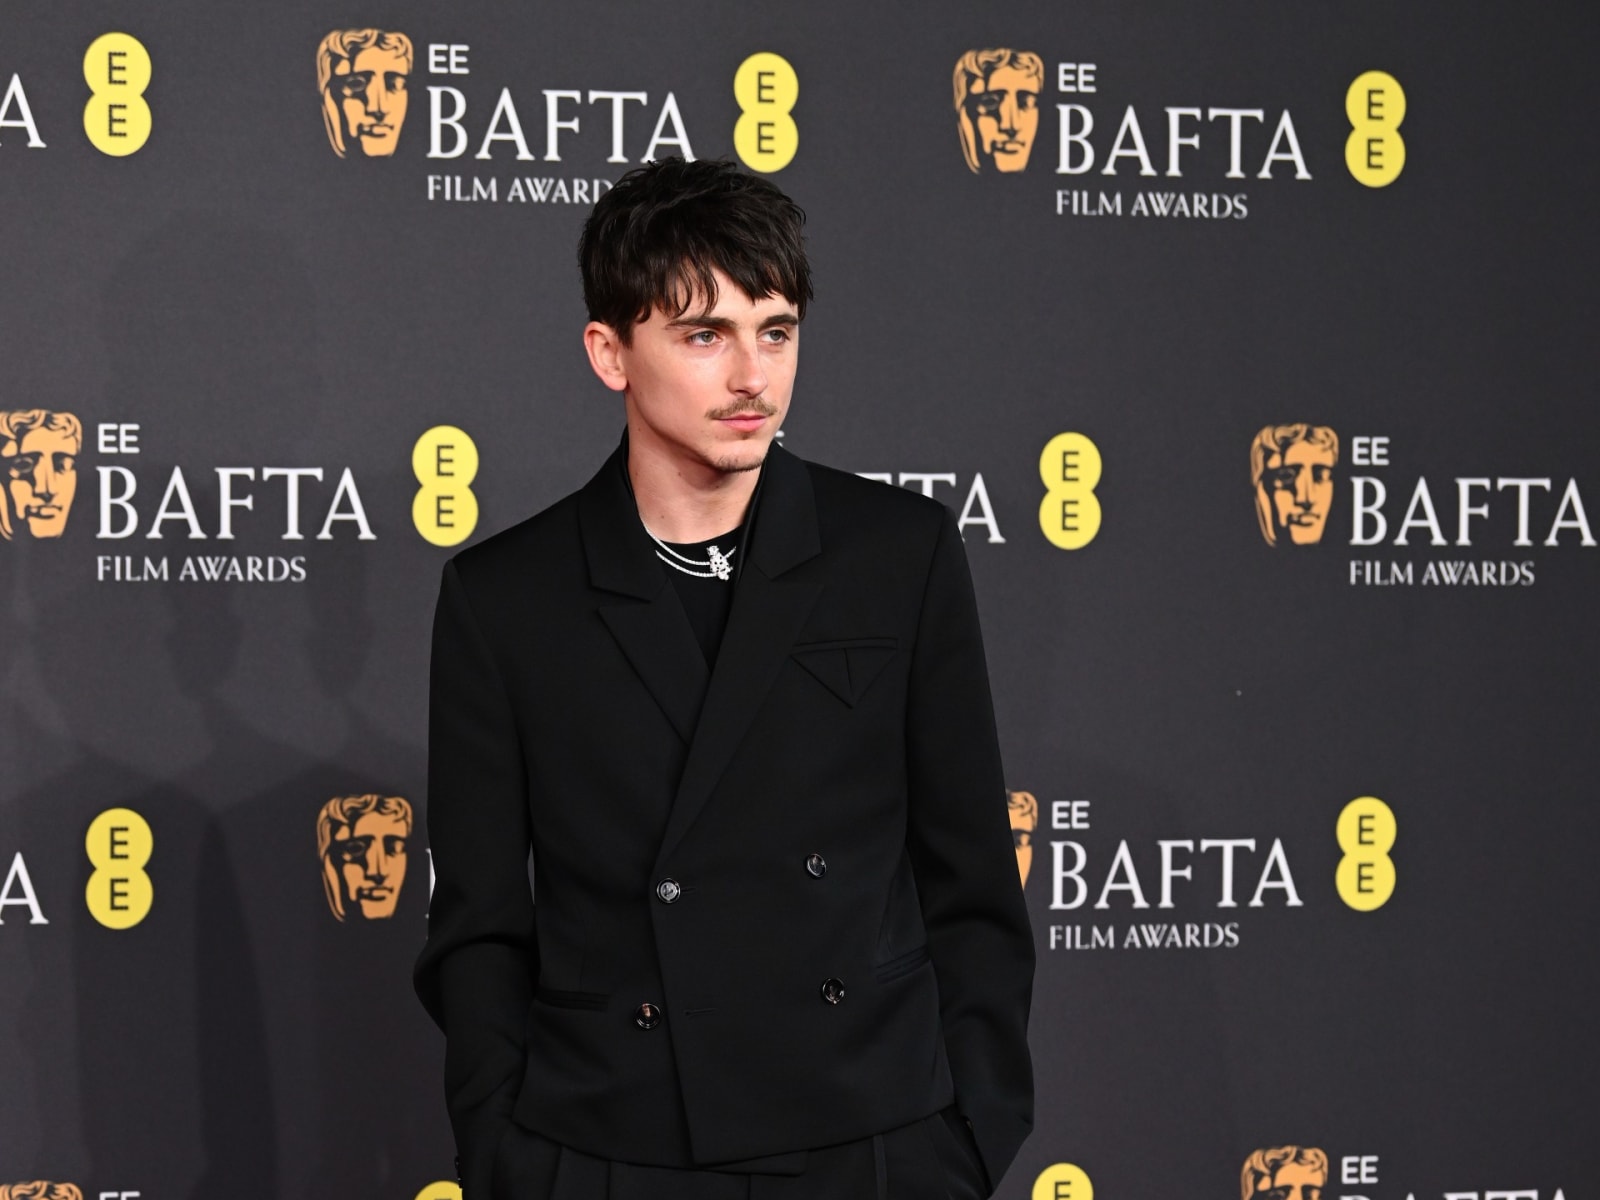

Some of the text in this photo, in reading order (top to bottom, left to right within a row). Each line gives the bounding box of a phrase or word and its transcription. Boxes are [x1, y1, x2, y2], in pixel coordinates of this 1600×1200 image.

[429, 44, 469, 74] EE
[1058, 63, 1096, 92] EE
[426, 86, 697, 162] BAFTA
[1056, 104, 1312, 179] BAFTA
[428, 175, 613, 204] FILM AWARD
[1057, 190, 1247, 218] FILM AWARDS
[98, 423, 140, 454] EE
[1352, 437, 1389, 465] EE
[96, 466, 377, 540] BAFTA
[1350, 477, 1596, 546] BAFTA
[97, 556, 306, 582] FILM AWARDS
[1350, 561, 1534, 585] FILM AWARDS
[1052, 801, 1090, 829] EE
[1050, 838, 1303, 910] BAFTA
[1050, 923, 1239, 949] FILM AWARDS
[1342, 1156, 1378, 1184] EE
